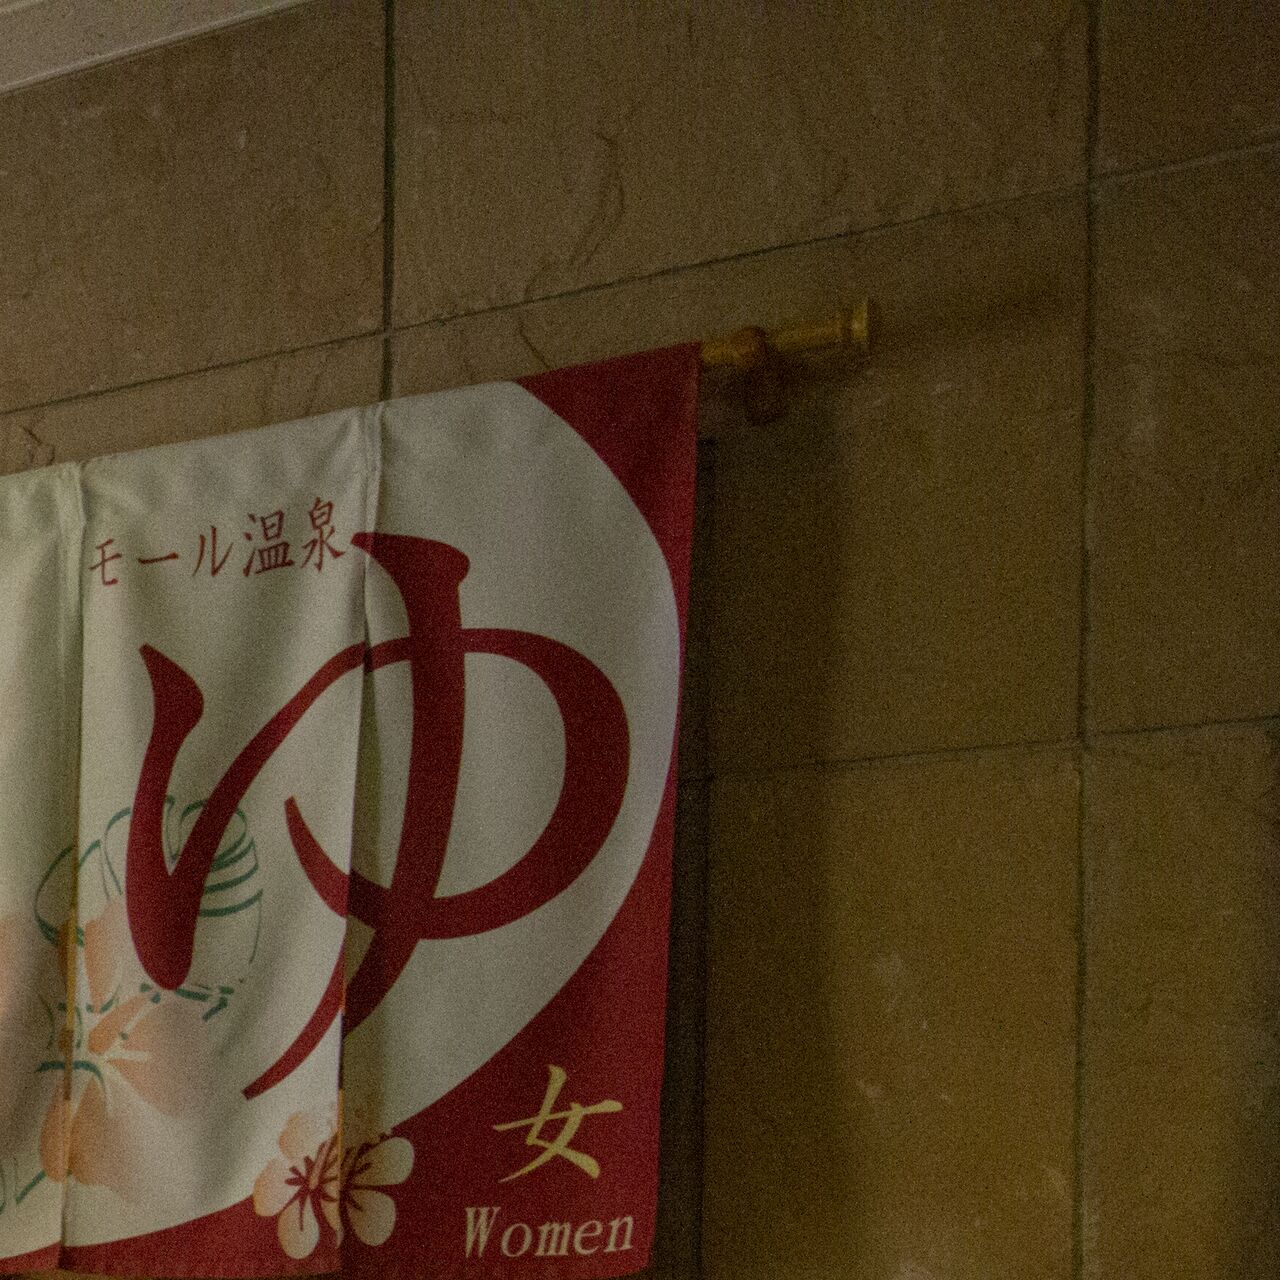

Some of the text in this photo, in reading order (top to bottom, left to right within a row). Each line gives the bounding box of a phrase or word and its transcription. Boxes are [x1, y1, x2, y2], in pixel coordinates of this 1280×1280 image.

[90, 497, 346, 586] モール温泉
[126, 532, 631, 1101] ゆ
[493, 1064, 623, 1185] 女
[463, 1206, 636, 1260] Women
